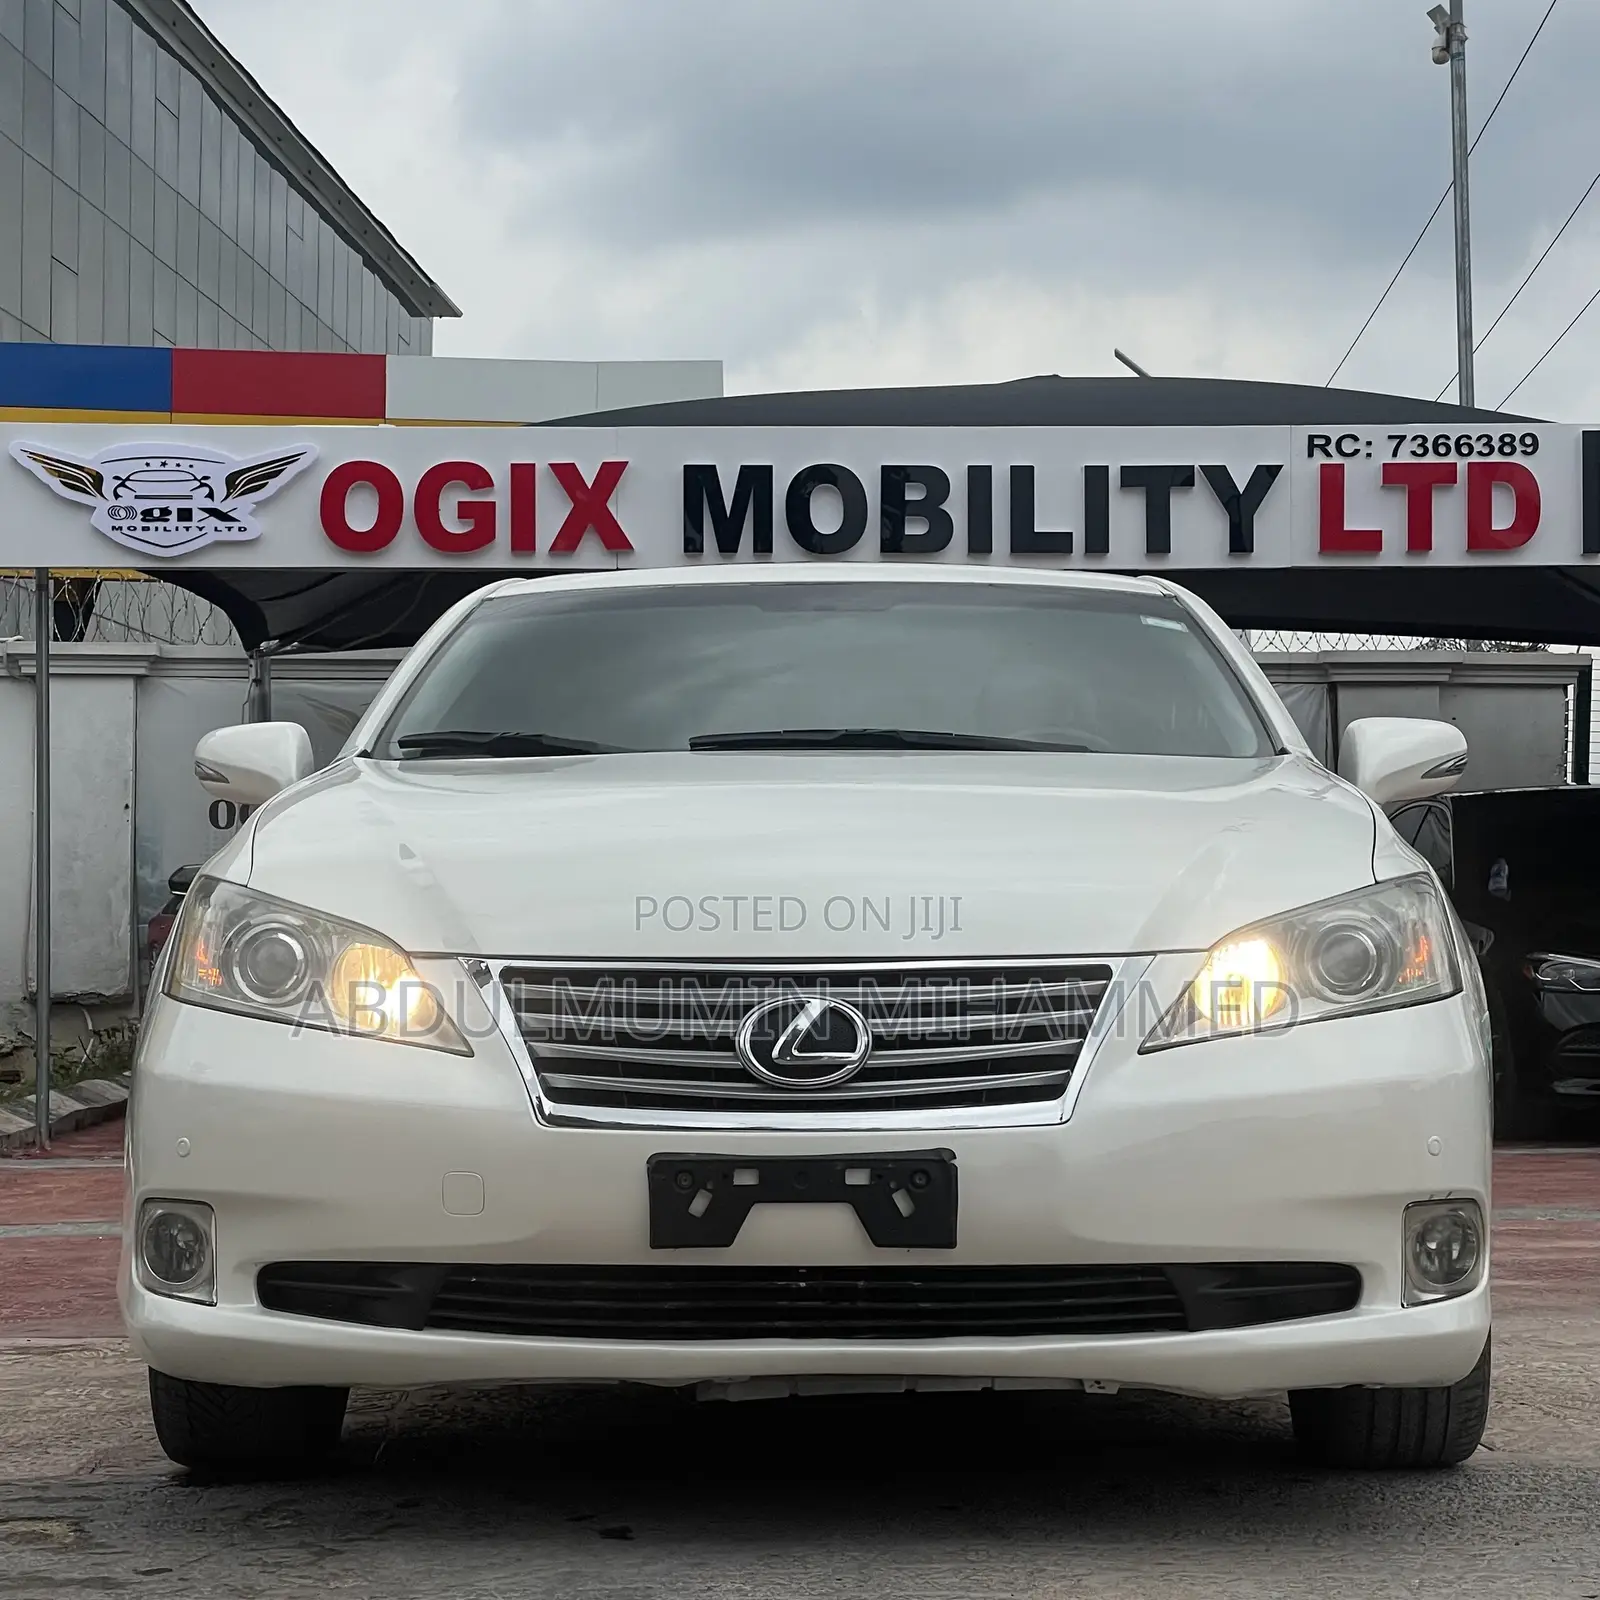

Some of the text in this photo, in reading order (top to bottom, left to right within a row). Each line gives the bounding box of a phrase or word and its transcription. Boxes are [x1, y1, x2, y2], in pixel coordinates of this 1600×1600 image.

[1306, 431, 1541, 459] RC: 7366389
[319, 459, 635, 555] OGIX
[682, 463, 1285, 556] MOBILITY
[1319, 460, 1542, 553] LTD
[111, 525, 248, 533] MOBILITY LTD
[208, 799, 256, 830] O
